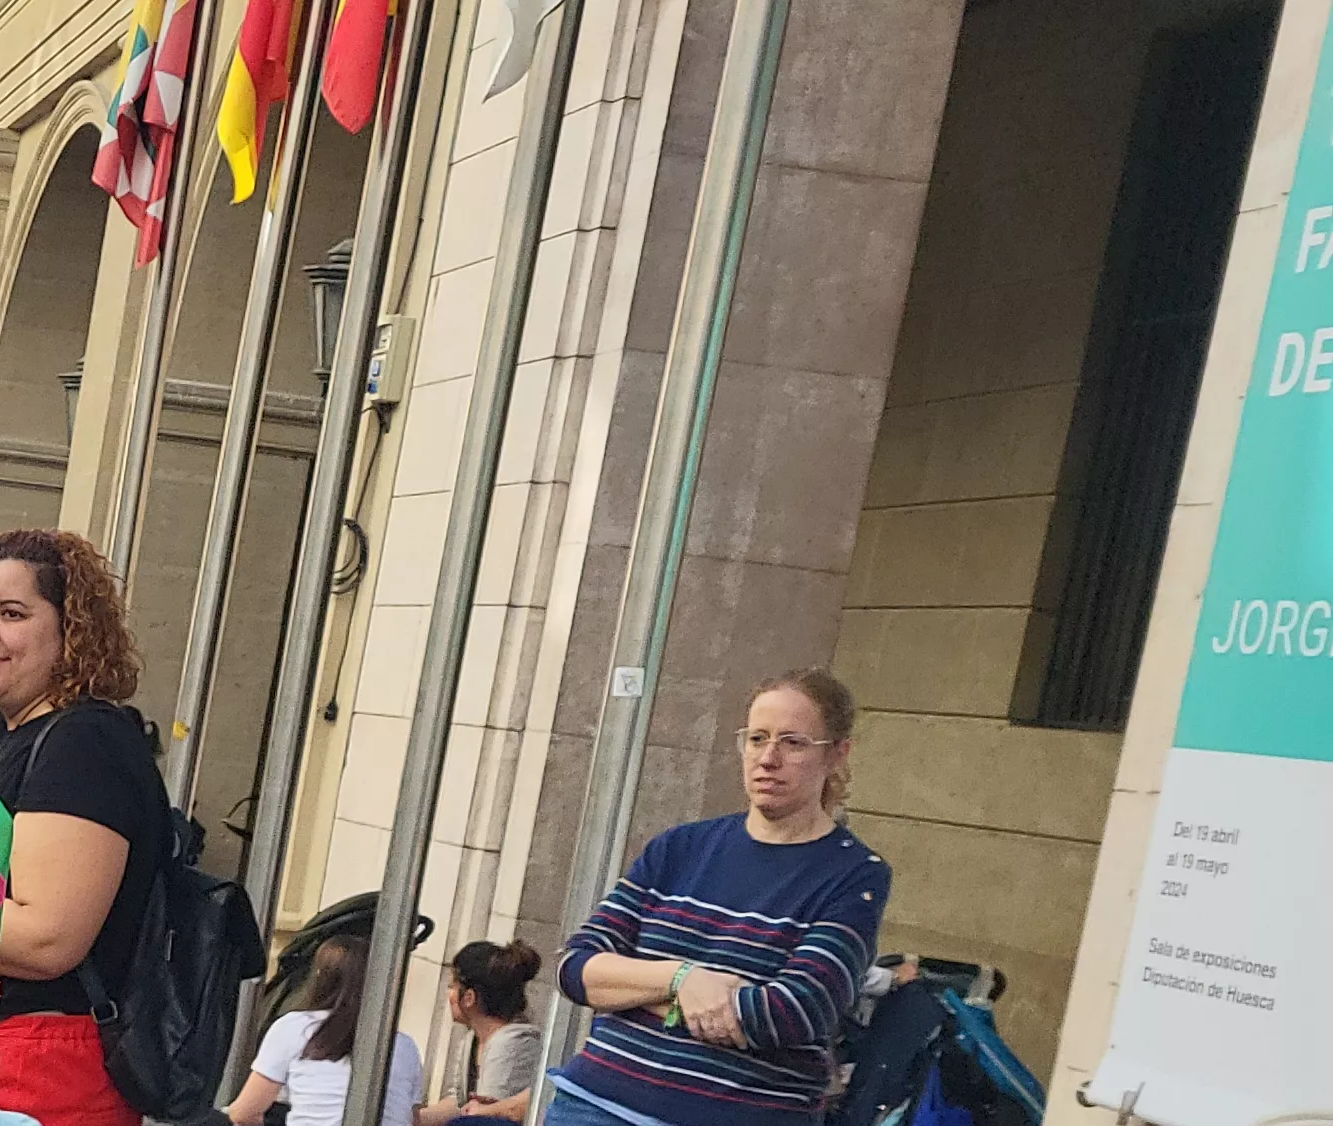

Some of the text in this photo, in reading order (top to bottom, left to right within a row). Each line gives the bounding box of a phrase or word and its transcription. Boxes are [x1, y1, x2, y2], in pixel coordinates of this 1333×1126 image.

[1212, 599, 1333, 657] JORG
[1174, 821, 1240, 845] Del 19 abril
[1166, 852, 1229, 878] al 19 mayo
[1160, 880, 1189, 897] 2024
[1149, 937, 1277, 979] Sala de exposiciones
[1208, 982, 1223, 999] de
[1226, 985, 1275, 1011] Huesca
